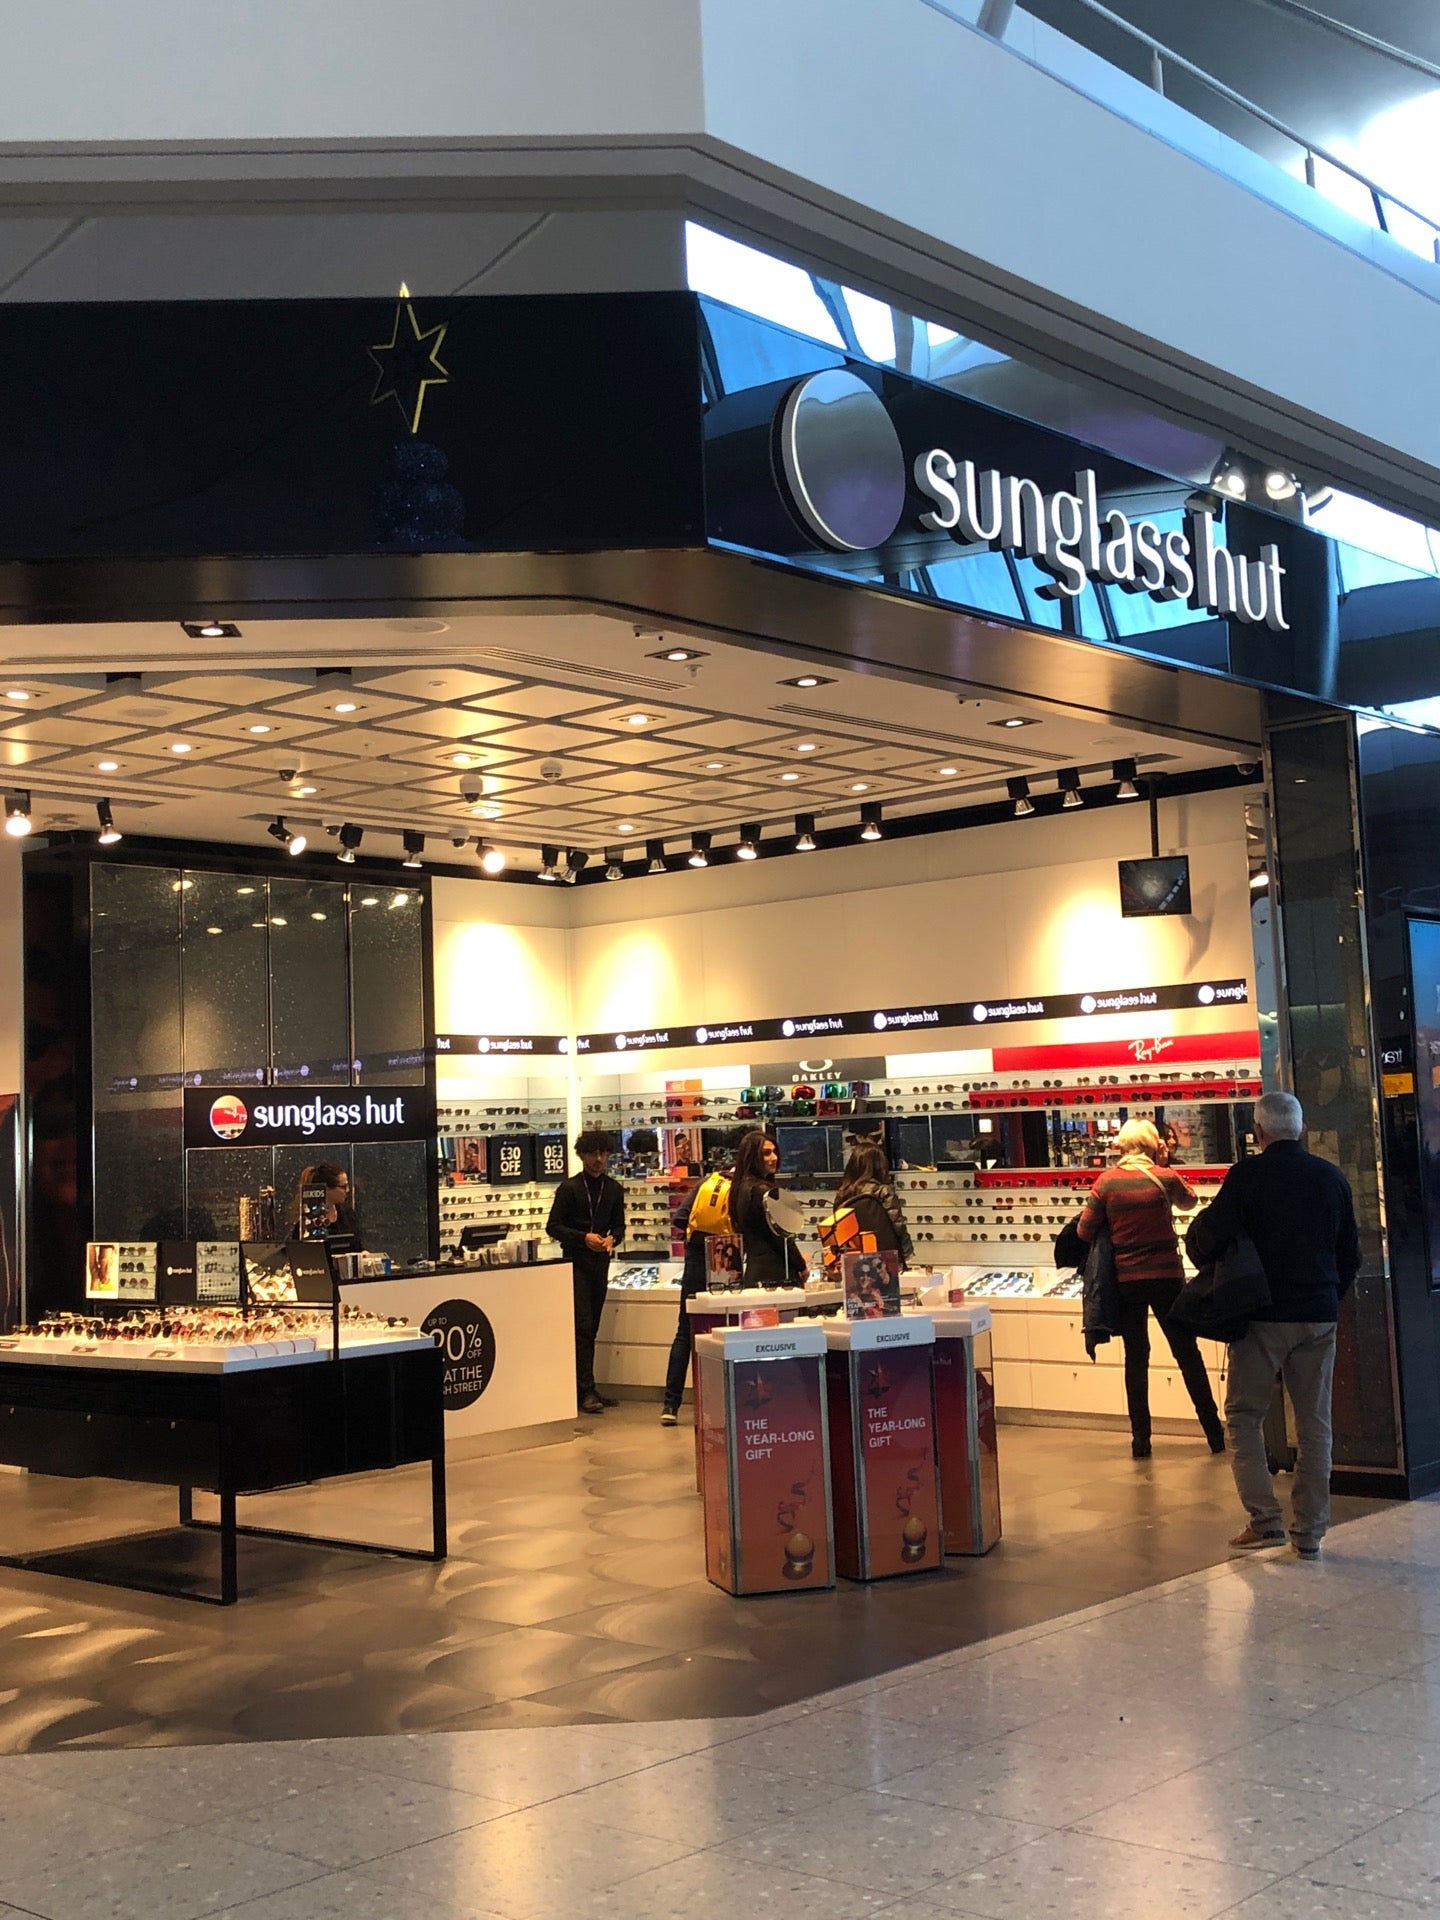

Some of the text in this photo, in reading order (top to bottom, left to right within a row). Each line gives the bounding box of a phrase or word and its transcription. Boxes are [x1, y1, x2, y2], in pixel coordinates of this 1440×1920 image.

[914, 448, 1291, 630] sunglass hut
[1139, 992, 1158, 1005] hut
[1027, 1001, 1044, 1014] hut
[1128, 1036, 1174, 1061] Ray-Ban
[792, 1071, 842, 1082] OAKLEY
[253, 1094, 405, 1136] sunglass hut
[500, 1146, 521, 1160] £30
[500, 1160, 521, 1172] OFF
[428, 1317, 448, 1327] UP TO
[876, 1332, 911, 1343] EXCLUSIVE
[466, 1349, 482, 1359] OFF
[755, 1342, 797, 1353] EXCLUSIVE
[443, 1364, 483, 1384] AT THE
[453, 1380, 483, 1395] STREET
[867, 1406, 888, 1419] THE
[744, 1418, 769, 1431] THE
[868, 1417, 926, 1434] YEAR-LONG
[744, 1430, 815, 1445] YEAR-LONG
[869, 1435, 892, 1448] GIFT
[745, 1448, 773, 1461] GIFT
